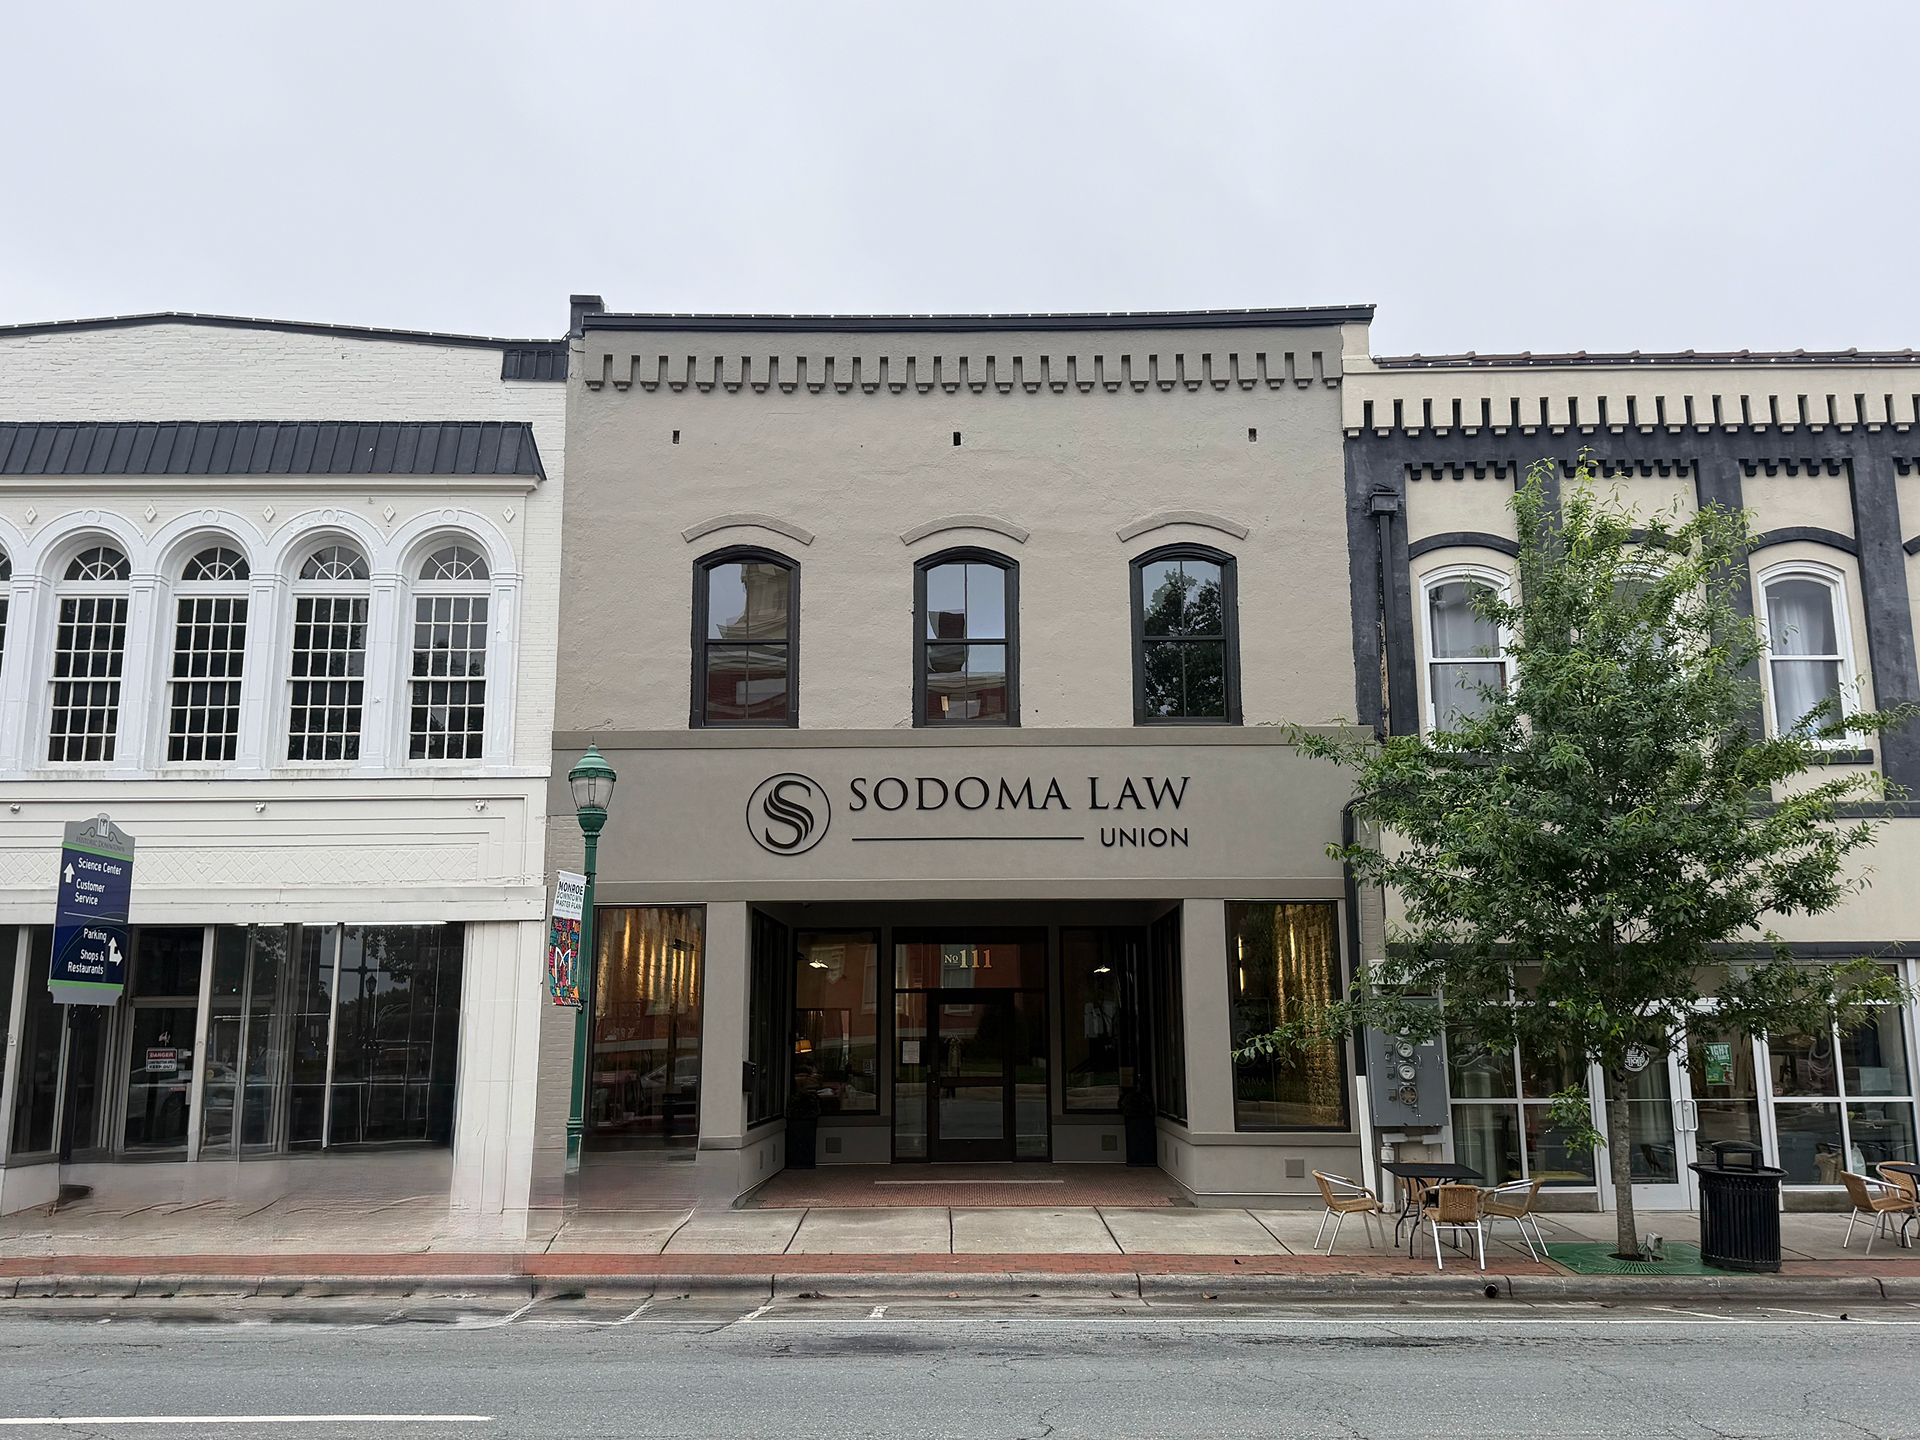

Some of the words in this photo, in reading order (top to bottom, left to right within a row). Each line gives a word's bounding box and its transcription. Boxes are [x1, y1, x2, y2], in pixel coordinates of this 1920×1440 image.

[849, 776, 1072, 812] SODOMA
[1087, 776, 1191, 810] LAW
[1100, 827, 1189, 848] UNION
[78, 857, 102, 872] Science
[103, 862, 122, 875] Center
[76, 878, 105, 893] Customer
[558, 881, 583, 895] MONROE
[74, 891, 99, 906] Service
[557, 891, 582, 903] DOWNTOWN
[555, 900, 571, 909] MASTER
[571, 902, 582, 910] PLAN
[83, 928, 107, 944] Parking
[80, 949, 98, 963] Shops
[99, 951, 105, 961] &
[960, 949, 992, 968] 111
[67, 961, 104, 975] Restaurants
